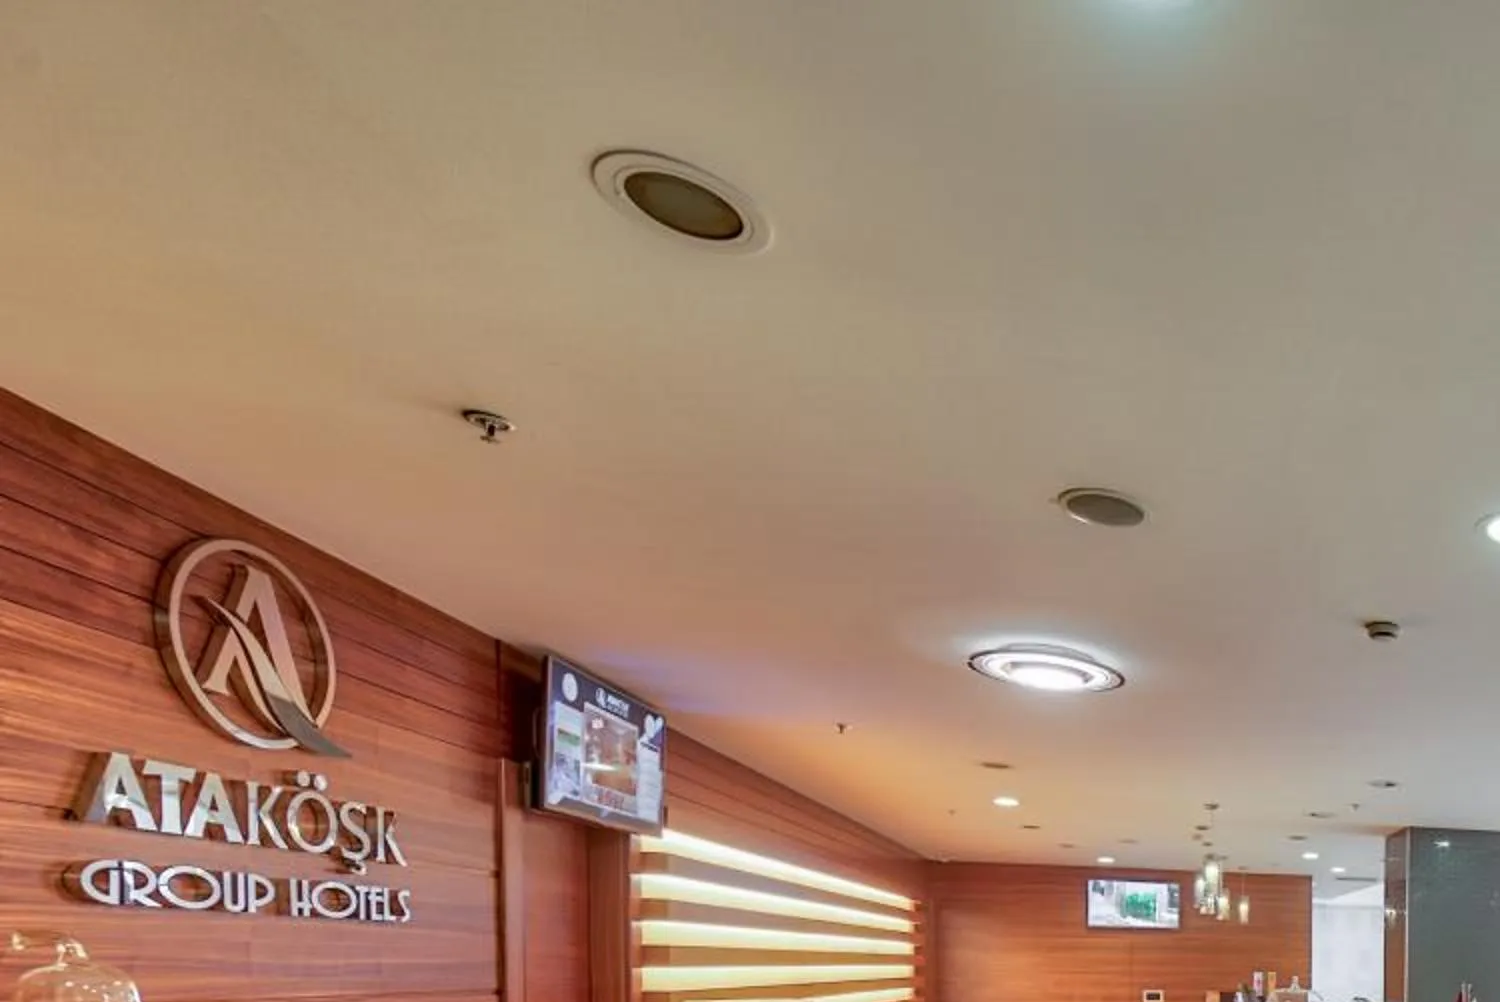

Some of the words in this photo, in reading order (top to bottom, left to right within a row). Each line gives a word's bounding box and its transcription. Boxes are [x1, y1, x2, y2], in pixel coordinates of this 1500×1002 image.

[84, 751, 408, 876] ATAKÖŞK
[80, 858, 276, 913] GROUP
[289, 876, 412, 923] HOTELS
